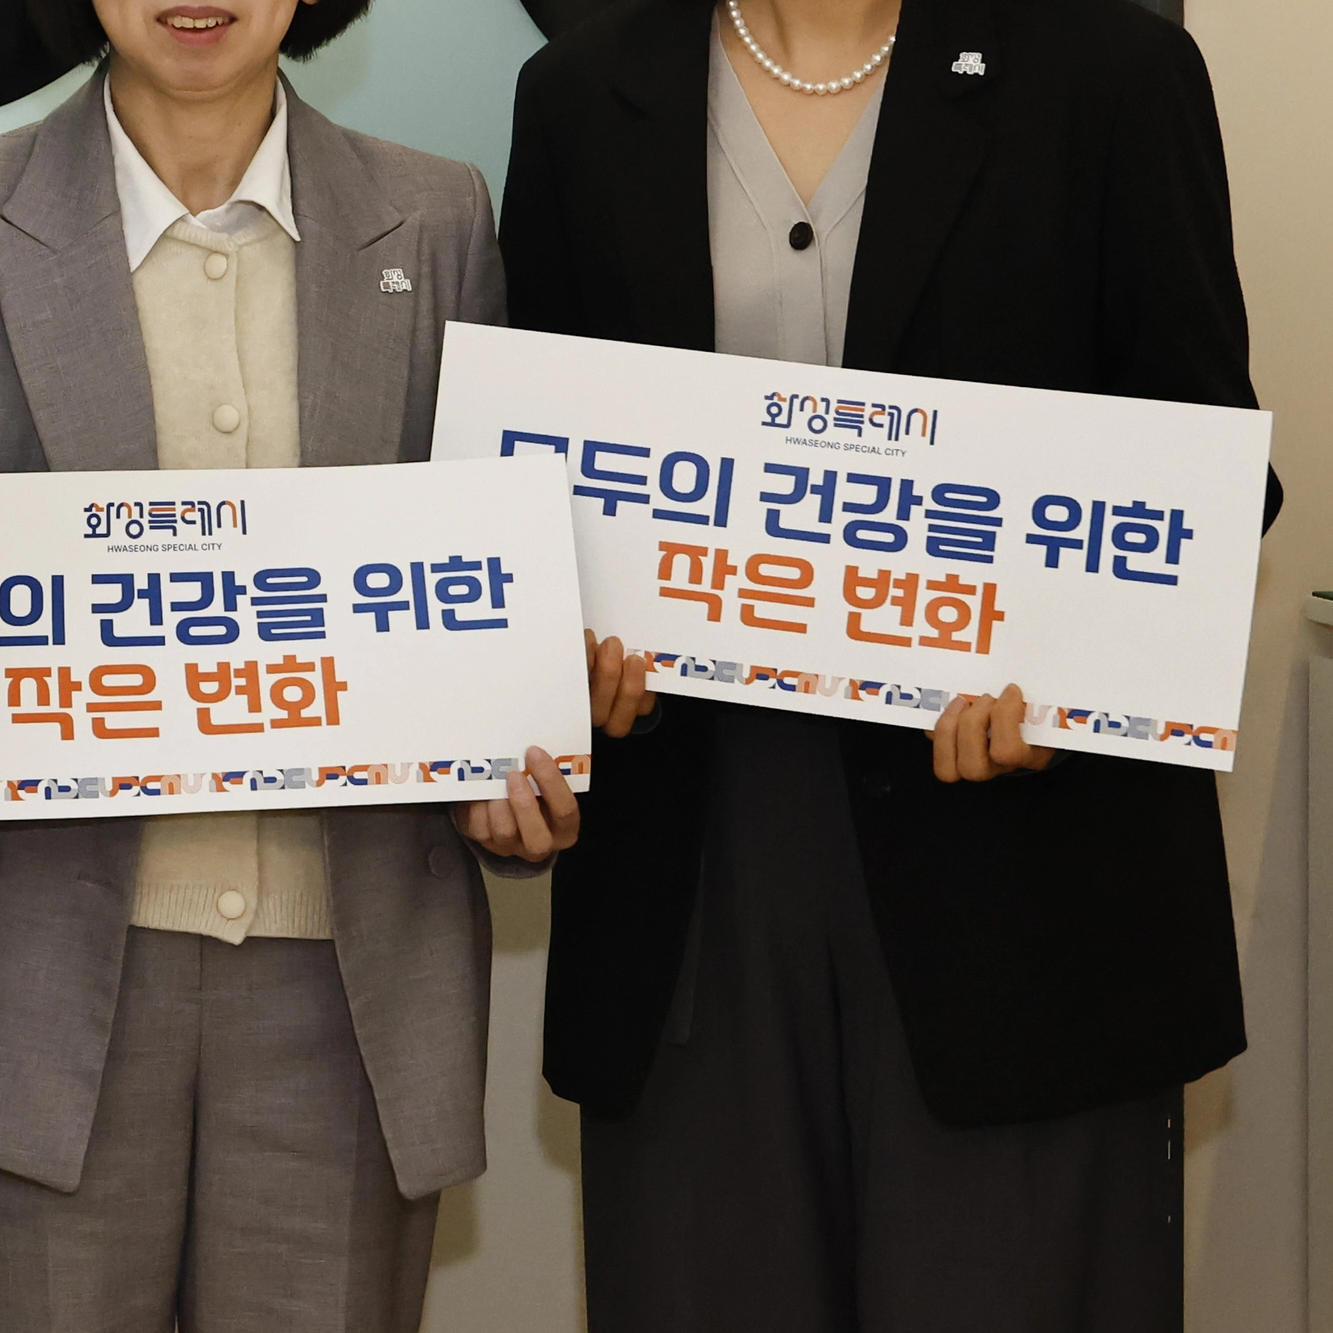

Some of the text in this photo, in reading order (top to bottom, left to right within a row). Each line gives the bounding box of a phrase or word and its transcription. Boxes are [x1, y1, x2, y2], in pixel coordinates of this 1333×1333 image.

[761, 391, 938, 446] 화성특례시
[785, 436, 908, 457] HWASEONG SPECIAL CITY
[83, 499, 248, 540] 화성특례시
[107, 543, 223, 553] HWASEONG SPECIAL CITY
[759, 462, 1003, 564] 건강을
[1025, 494, 1194, 586] 위한
[90, 566, 328, 648] 건강을
[352, 555, 514, 633] 위한
[657, 540, 1006, 656] 작은 변화
[4, 654, 349, 742] 작은 변화
